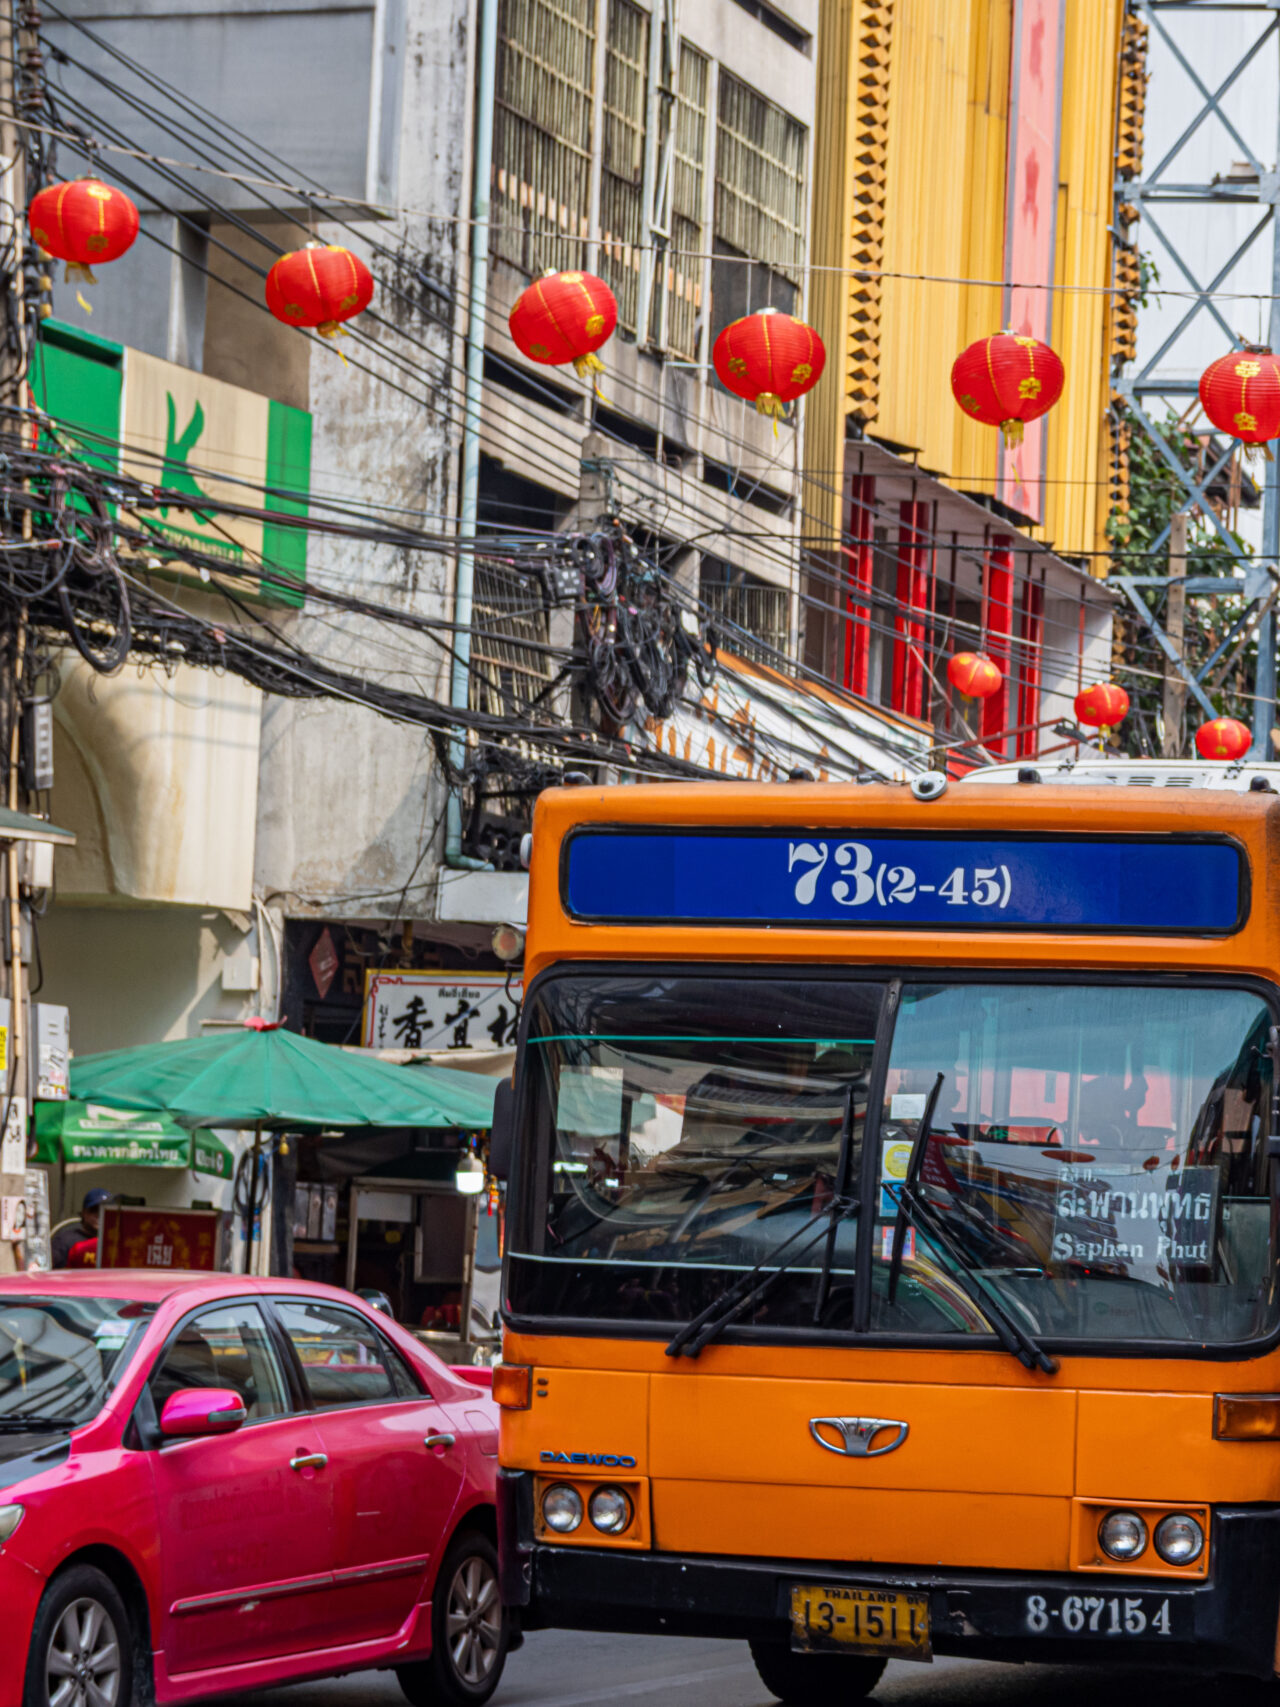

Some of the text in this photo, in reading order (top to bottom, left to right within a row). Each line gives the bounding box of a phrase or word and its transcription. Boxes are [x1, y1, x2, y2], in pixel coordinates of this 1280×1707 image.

[540, 1450, 638, 1468] DAEWOO
[824, 1589, 897, 1604] THAILAND
[1026, 1594, 1172, 1636] 8-67154
